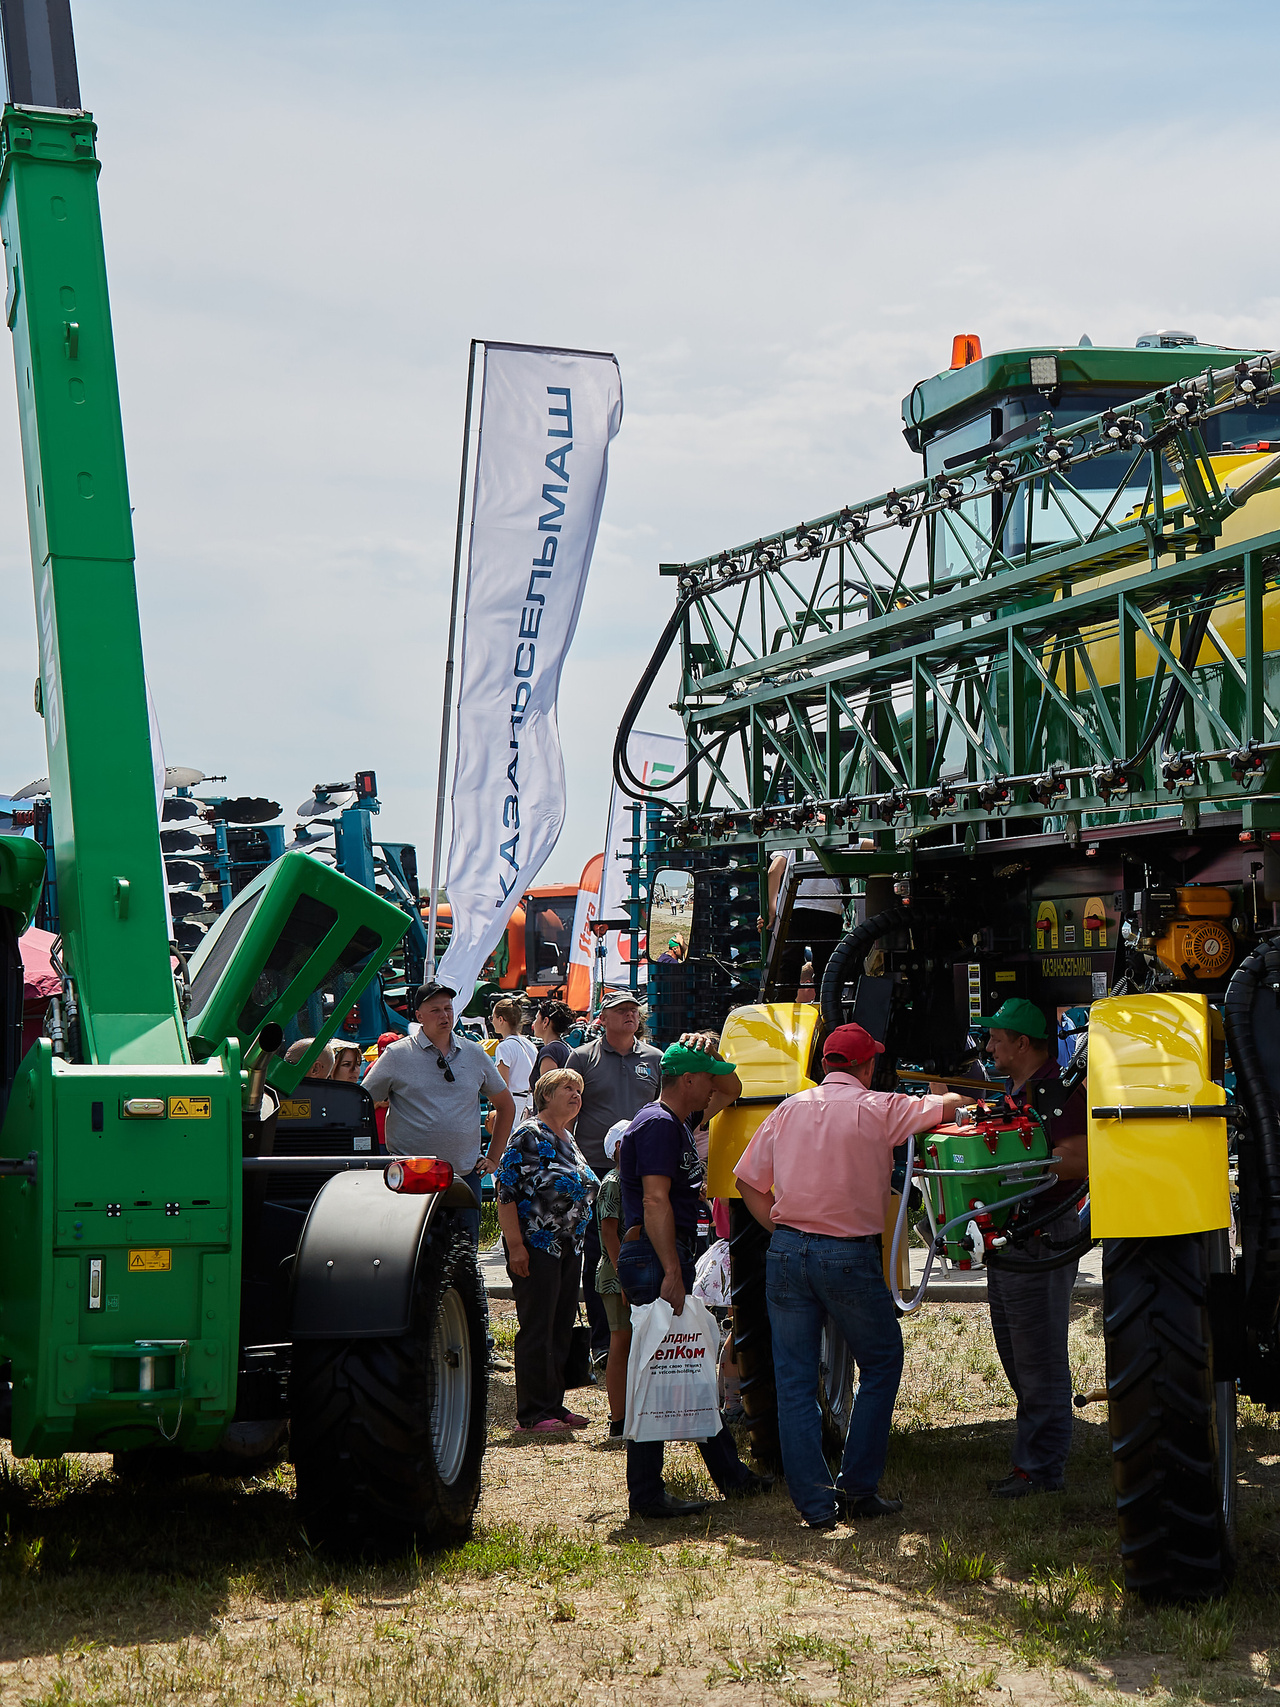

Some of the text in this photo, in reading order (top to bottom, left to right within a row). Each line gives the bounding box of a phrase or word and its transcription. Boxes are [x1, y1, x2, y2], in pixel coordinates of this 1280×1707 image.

[578, 901, 596, 959] Stara
[1041, 956, 1092, 978] КАЗАНЬСЕЛЬМАШ
[649, 1345, 705, 1361] елКом
